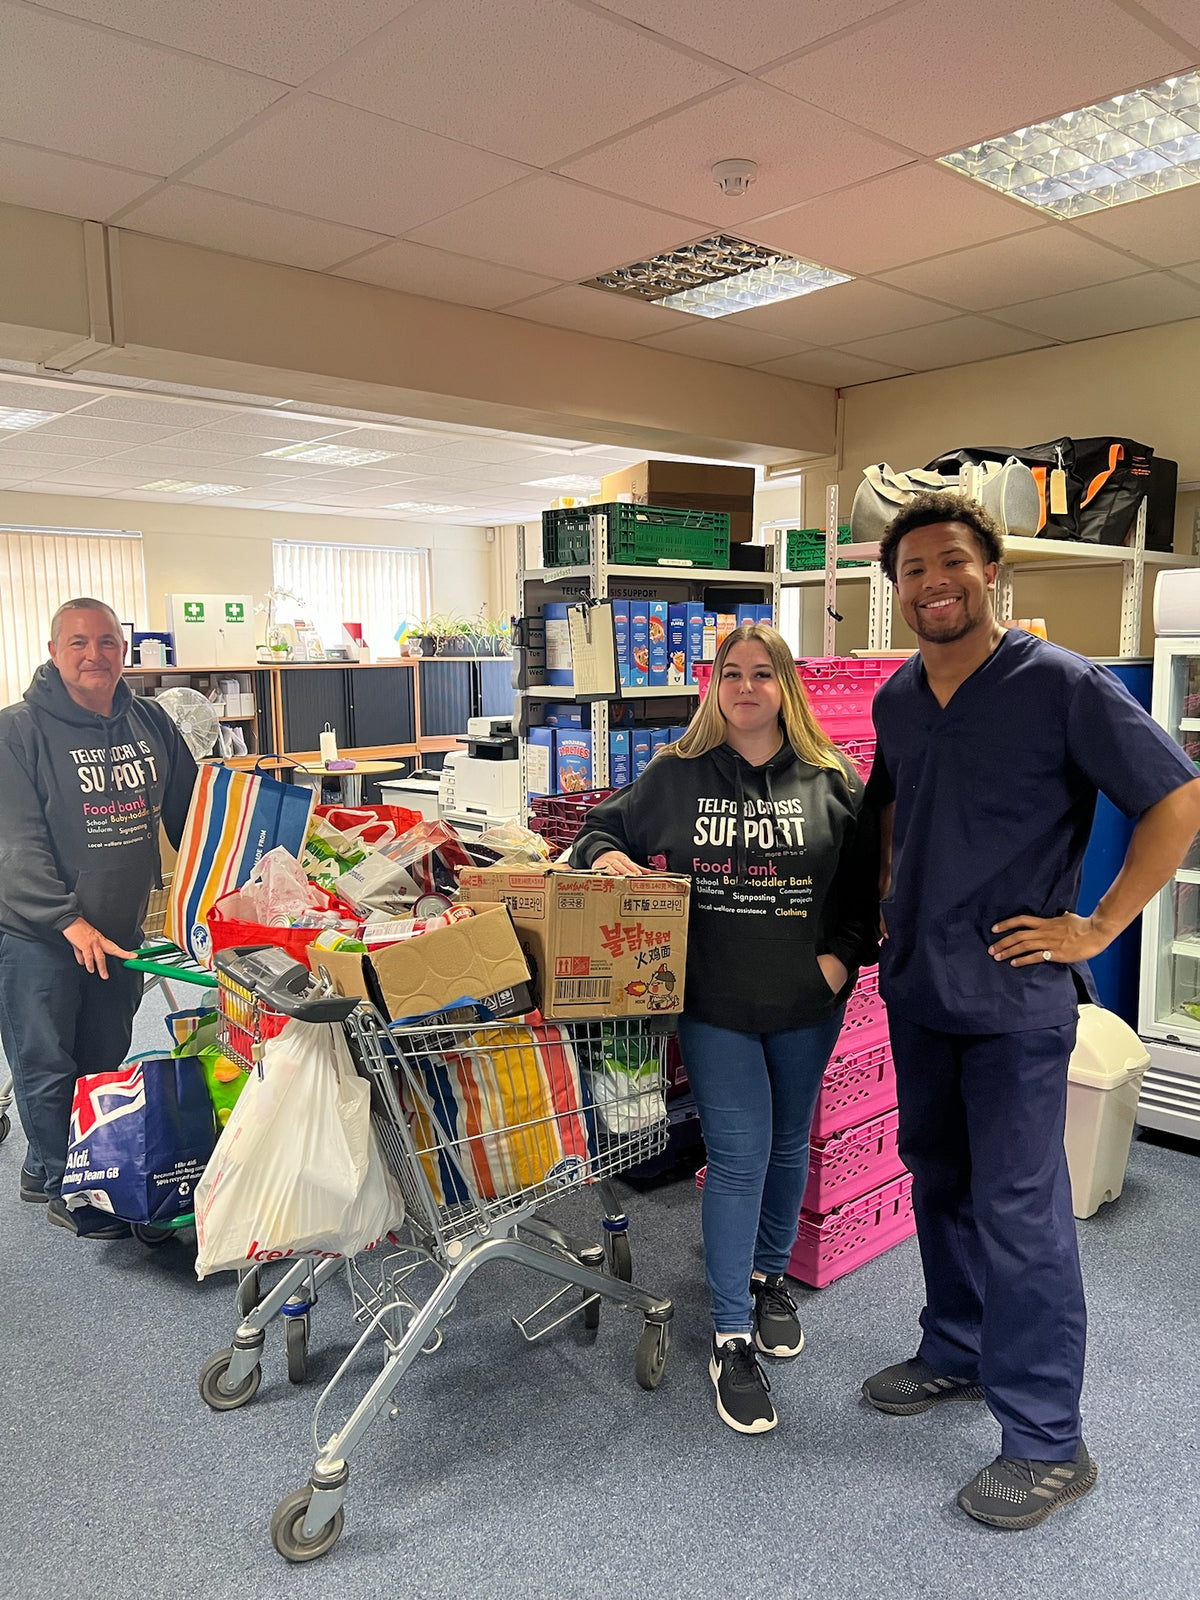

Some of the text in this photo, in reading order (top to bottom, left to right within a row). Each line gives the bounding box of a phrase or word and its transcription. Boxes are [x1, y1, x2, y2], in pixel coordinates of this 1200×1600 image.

[544, 568, 571, 581] Breakfast
[622, 588, 658, 598] SUPPORT
[558, 744, 590, 760] MALTIES
[83, 794, 146, 816] Food bank
[757, 798, 803, 816] CRISIS
[86, 818, 108, 827] School
[692, 857, 778, 876] Food ank
[695, 877, 720, 887] School
[789, 875, 813, 887] Bank
[696, 886, 813, 904] Uniform Signposting Community
[789, 897, 813, 905] projects
[651, 899, 682, 912] 오프라인
[736, 907, 767, 916] assistance
[774, 907, 808, 918] Clothing
[634, 944, 671, 969] 火鸡面
[83, 1169, 106, 1181] Team
[106, 1167, 120, 1179] GB
